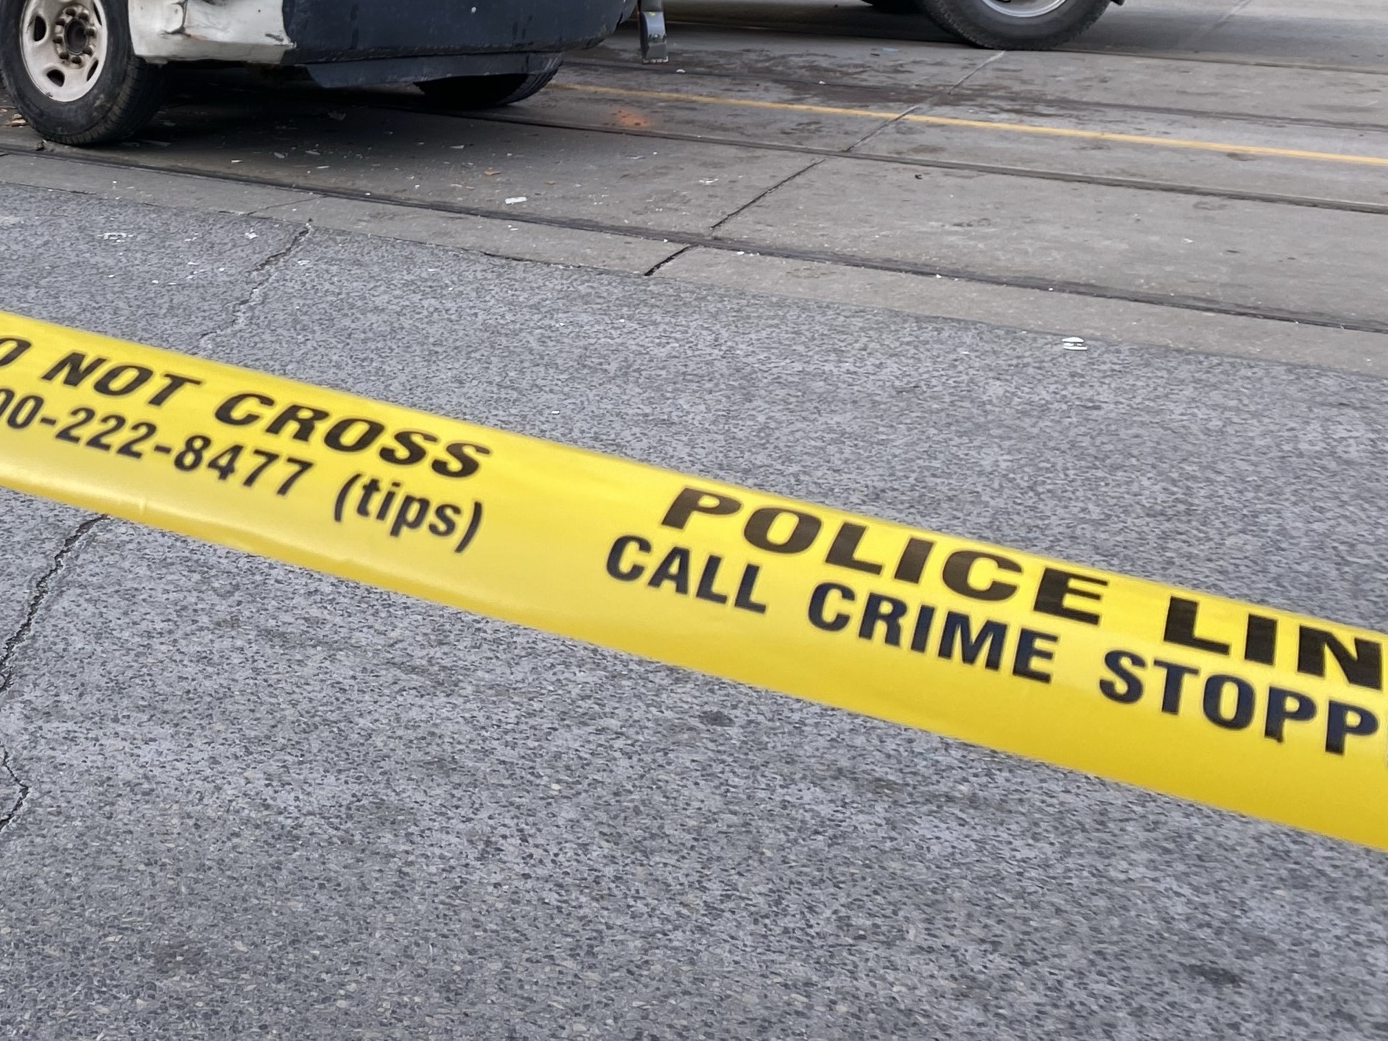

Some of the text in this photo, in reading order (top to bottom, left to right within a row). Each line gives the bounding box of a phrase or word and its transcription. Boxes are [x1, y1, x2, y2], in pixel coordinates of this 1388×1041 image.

[41, 350, 204, 408] NOT
[213, 391, 493, 480] CROSS
[333, 472, 485, 554] (tips)
[658, 485, 1385, 692] POLICE LIN
[603, 533, 1381, 758] CALL CRIME STOPP
